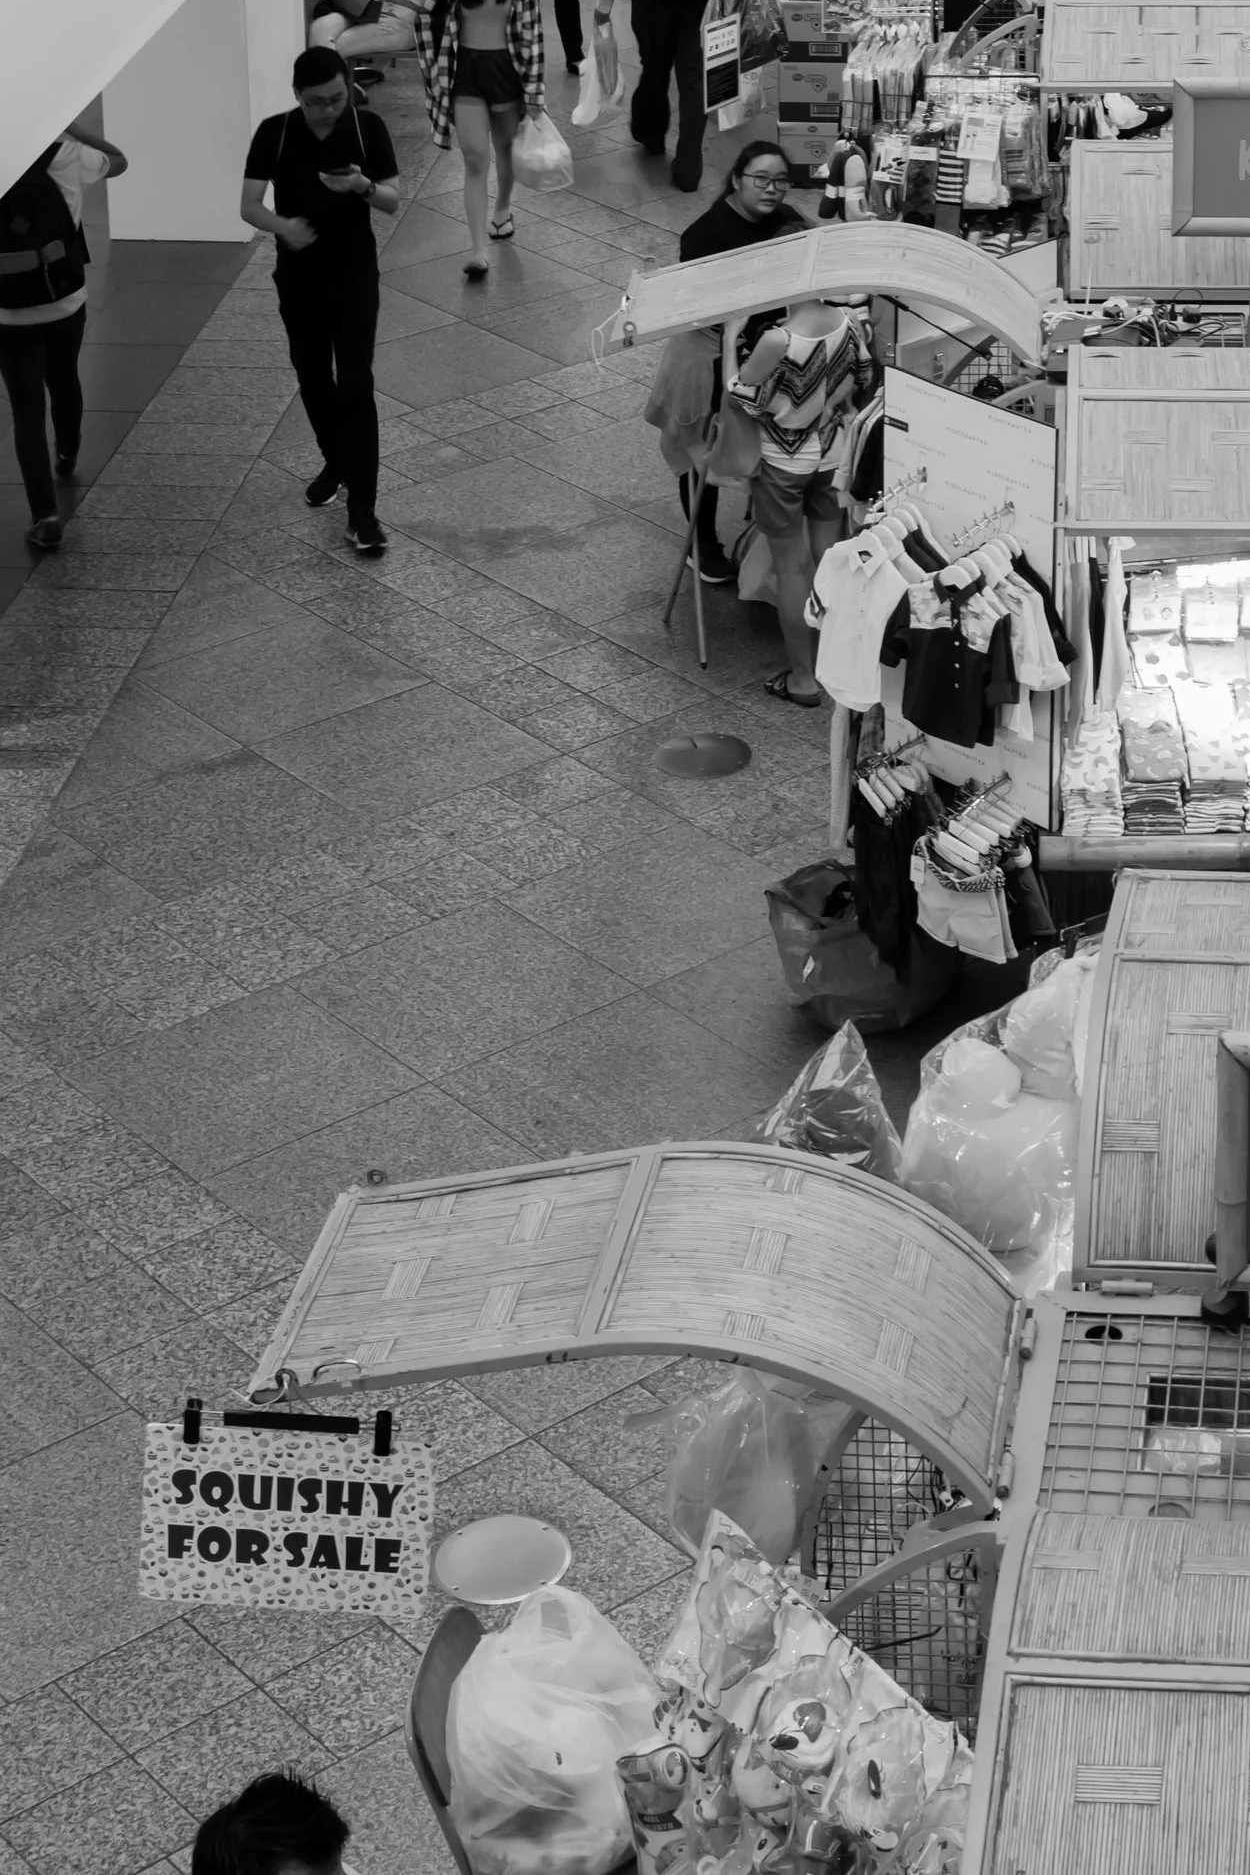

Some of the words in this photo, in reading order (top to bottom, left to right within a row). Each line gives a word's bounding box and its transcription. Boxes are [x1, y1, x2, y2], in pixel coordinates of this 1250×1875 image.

[171, 1468, 405, 1519] SQUISHY
[167, 1523, 271, 1568] FOR
[282, 1530, 403, 1575] SALE
